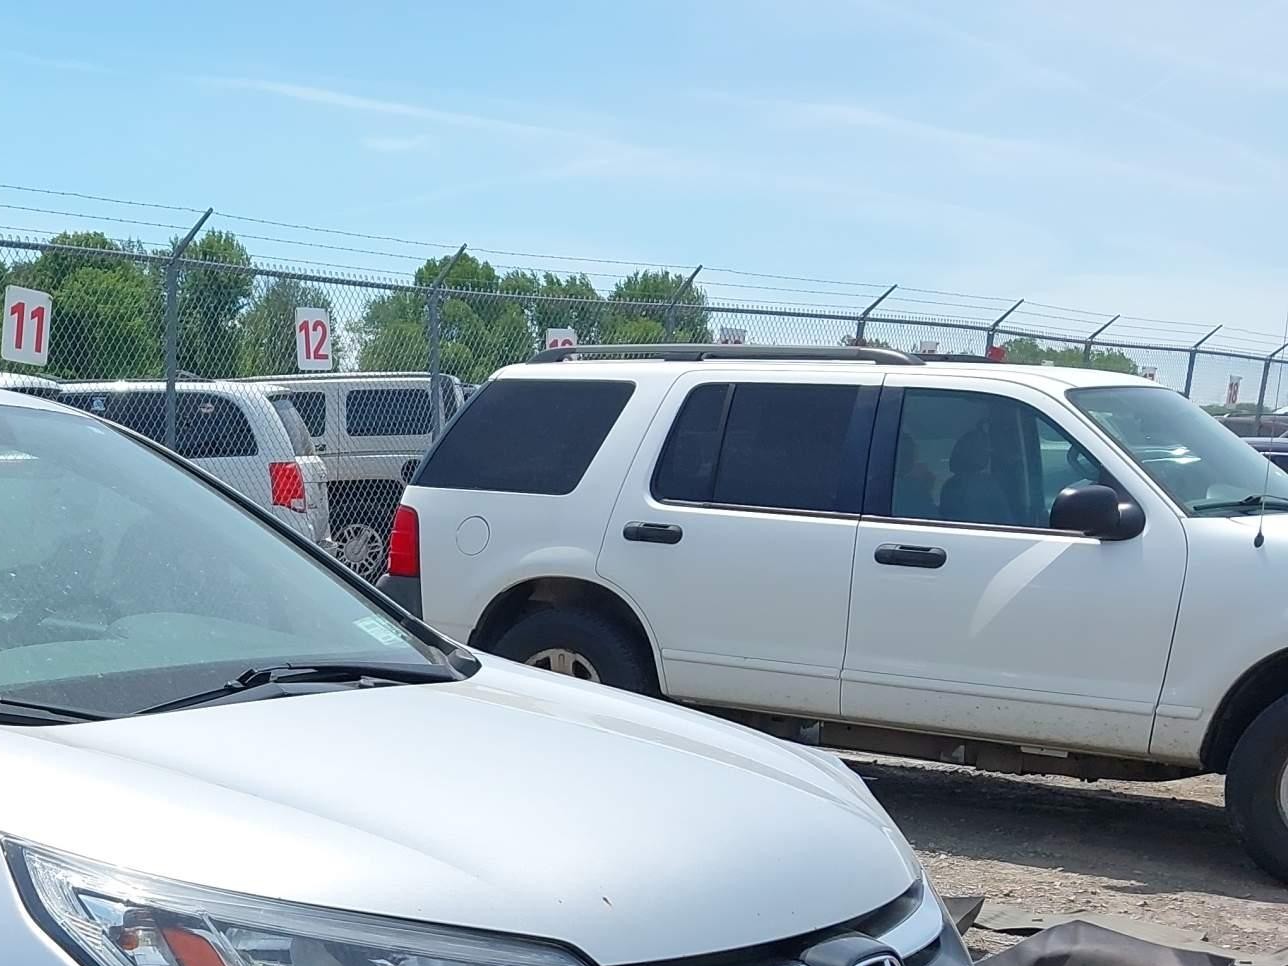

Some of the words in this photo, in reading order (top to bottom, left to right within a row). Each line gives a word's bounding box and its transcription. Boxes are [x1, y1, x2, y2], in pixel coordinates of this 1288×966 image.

[10, 301, 45, 353] 11
[298, 319, 329, 360] 12
[1227, 382, 1239, 404] 18
